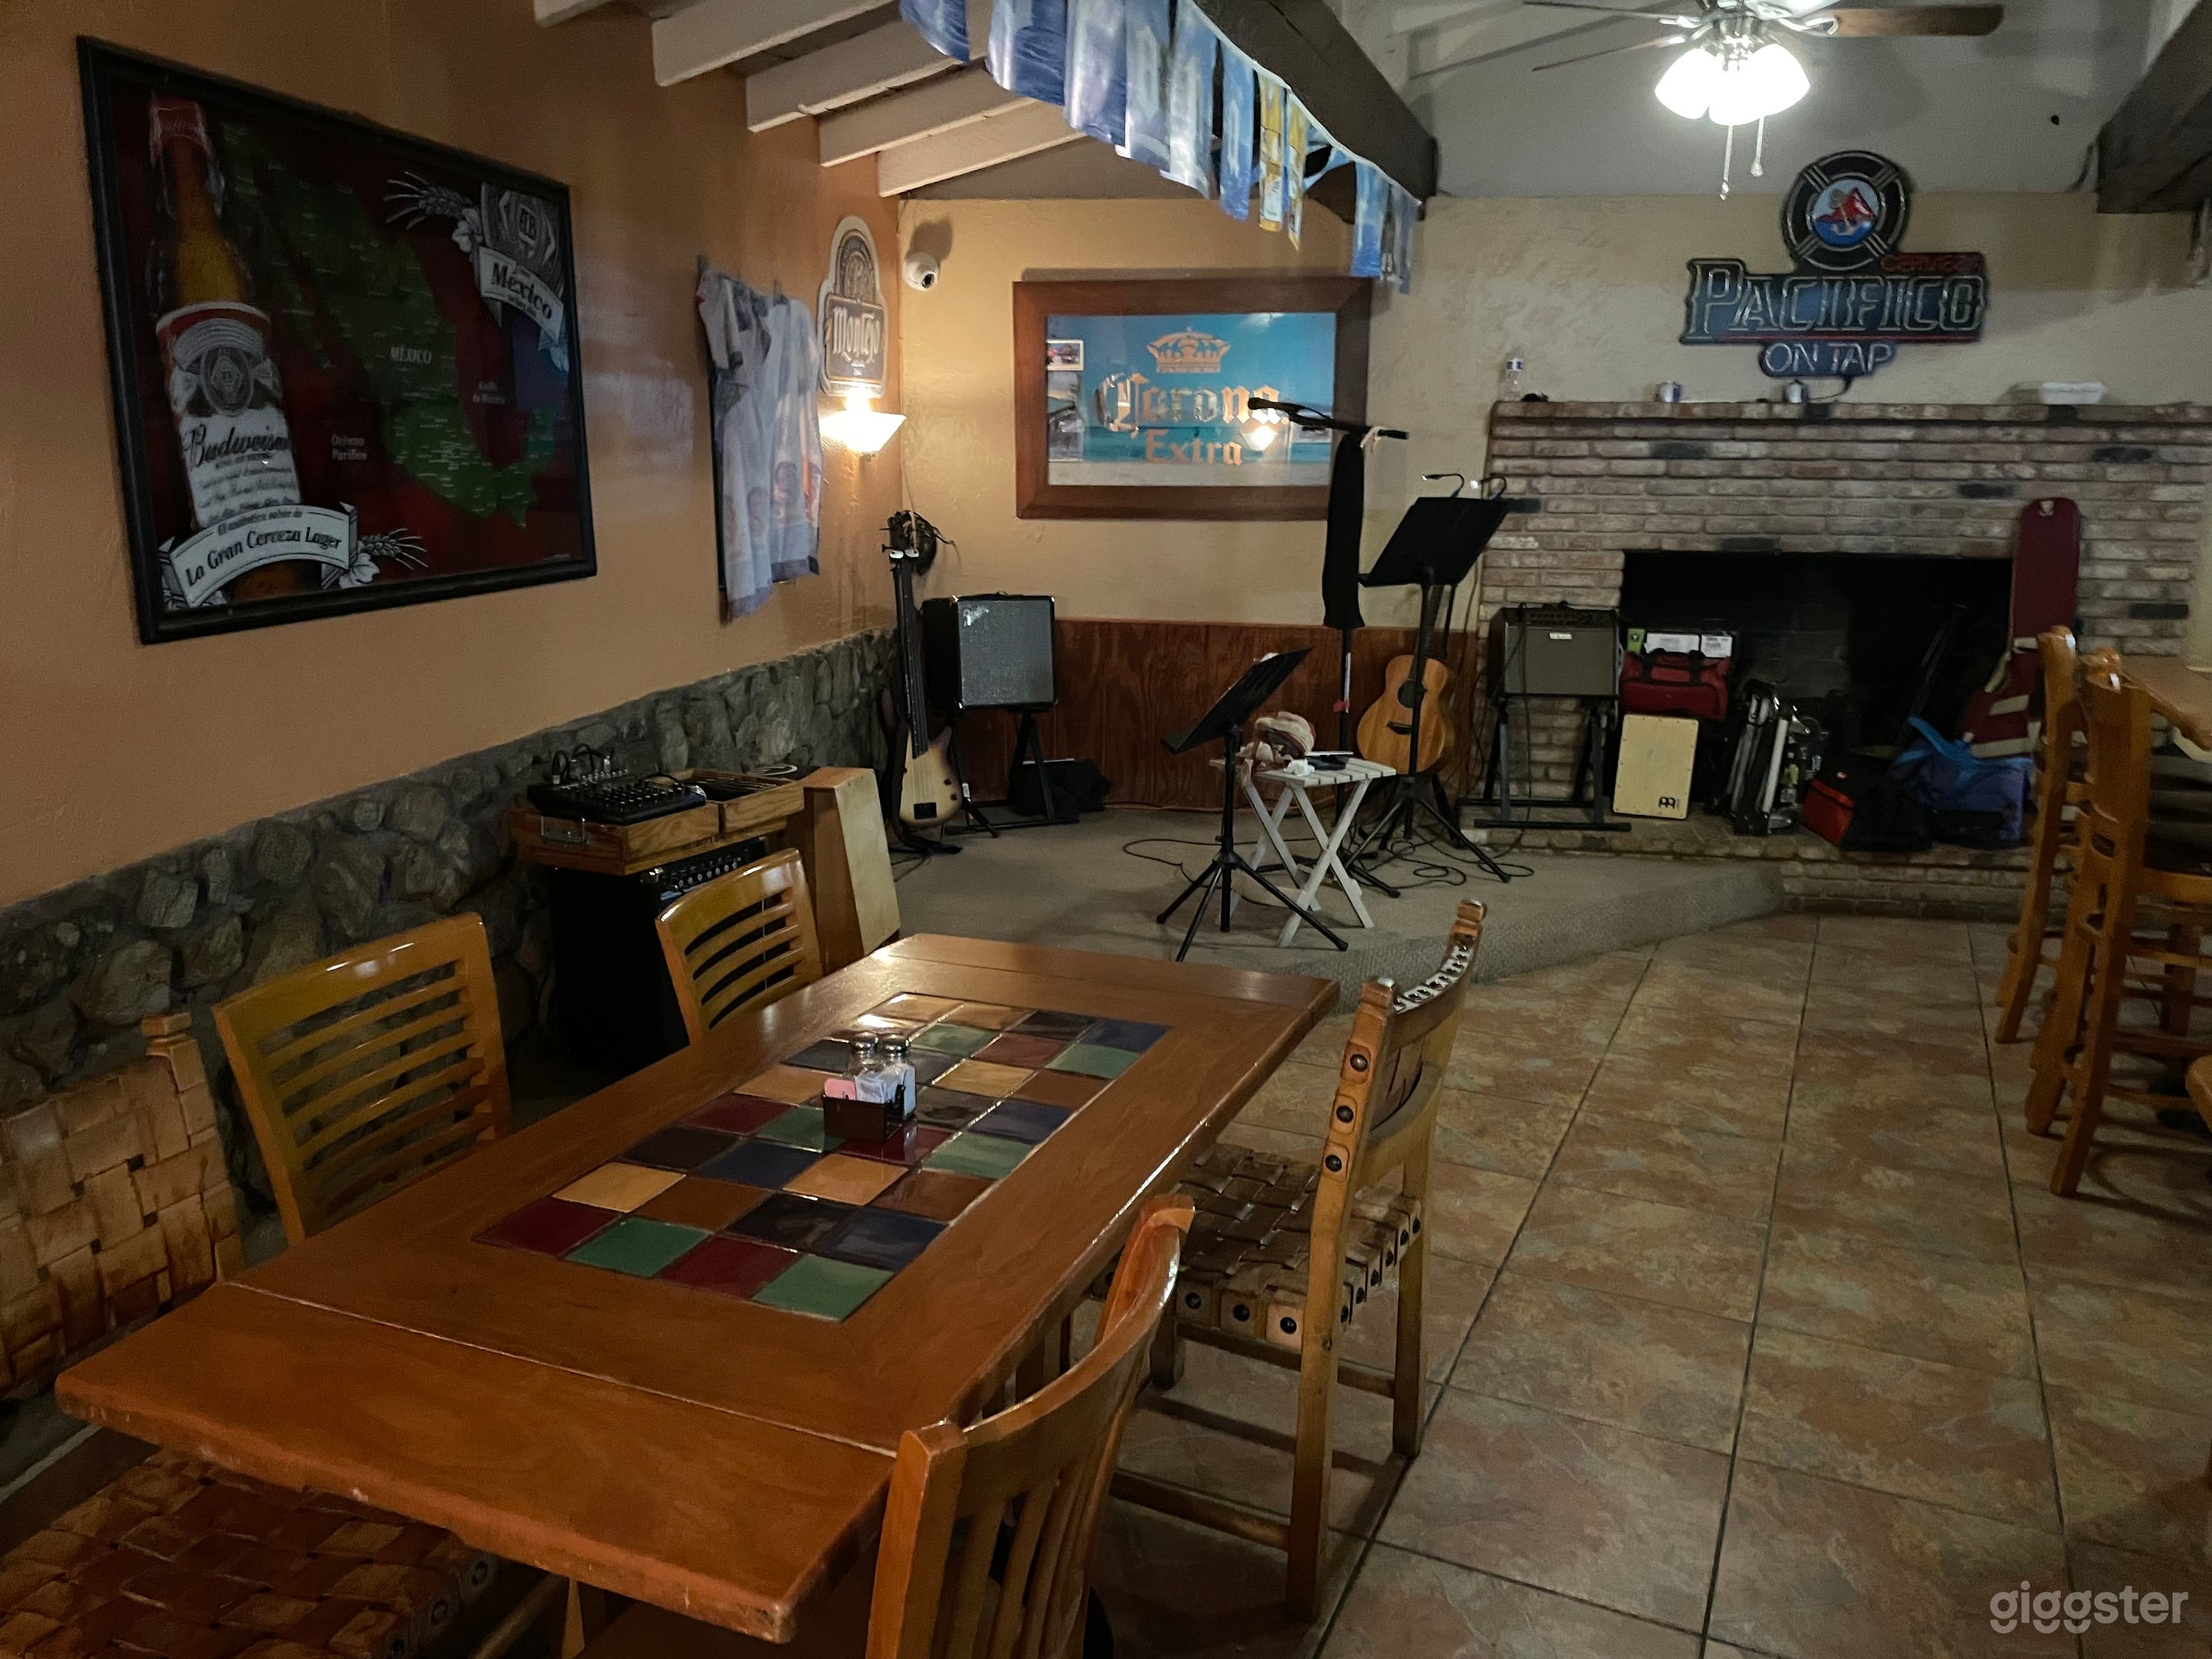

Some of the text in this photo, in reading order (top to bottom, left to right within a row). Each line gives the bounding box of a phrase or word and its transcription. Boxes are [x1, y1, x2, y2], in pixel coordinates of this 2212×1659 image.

[1681, 260, 1985, 339] PACIFICO
[1765, 343, 1893, 373] ON TAP
[1145, 429, 1243, 465] Extra
[186, 566, 205, 587] La
[207, 541, 243, 569] Gran
[305, 527, 343, 550] Lager
